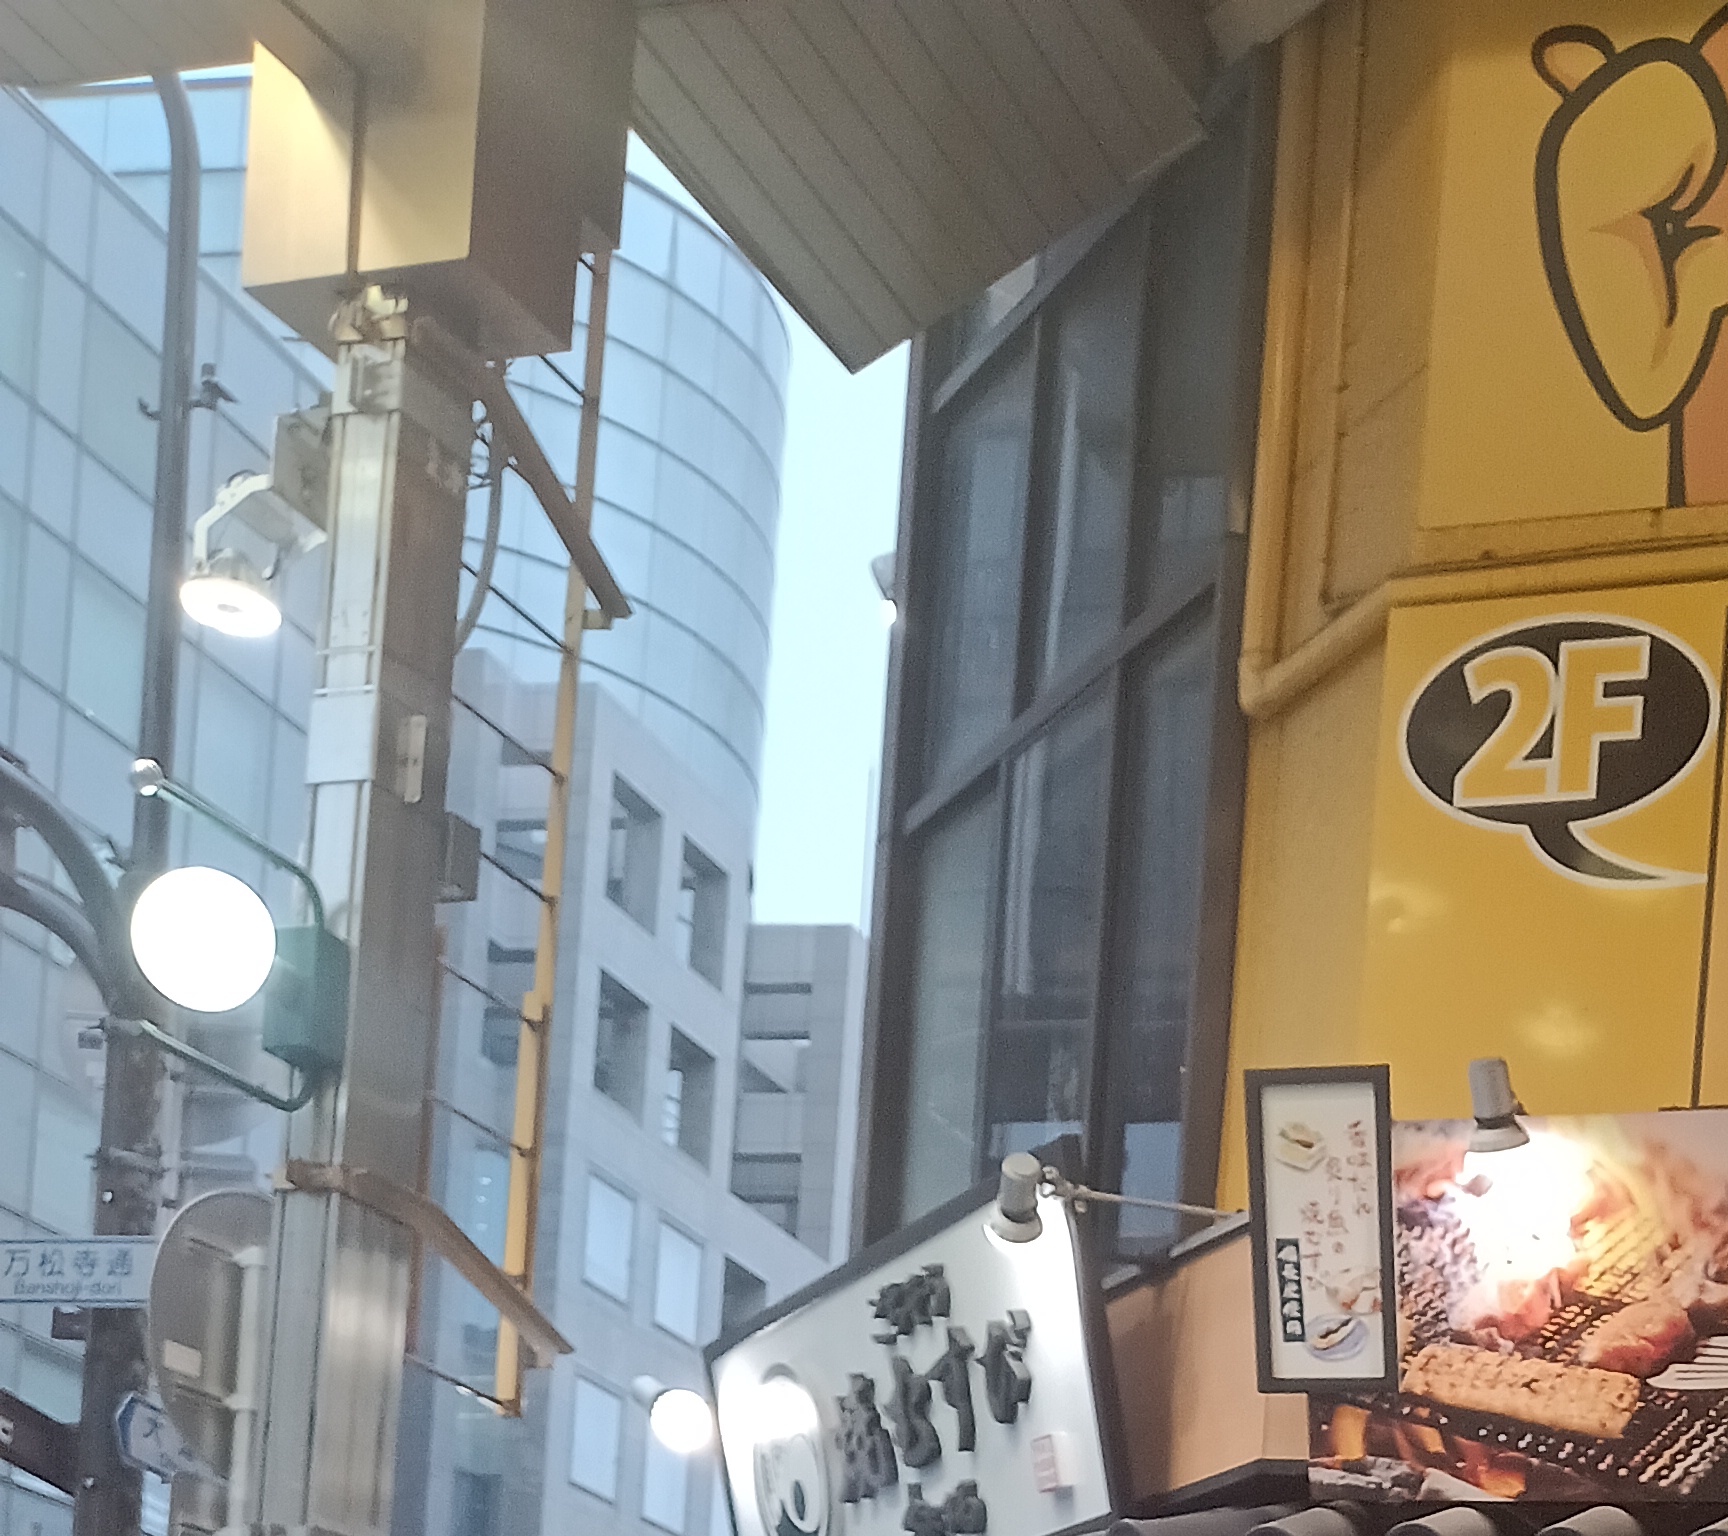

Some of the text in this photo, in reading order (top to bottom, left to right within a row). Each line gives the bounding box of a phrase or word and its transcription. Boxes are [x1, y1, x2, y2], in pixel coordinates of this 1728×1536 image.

[1453, 635, 1651, 808] 2F
[4, 1248, 134, 1278] 万松寺通
